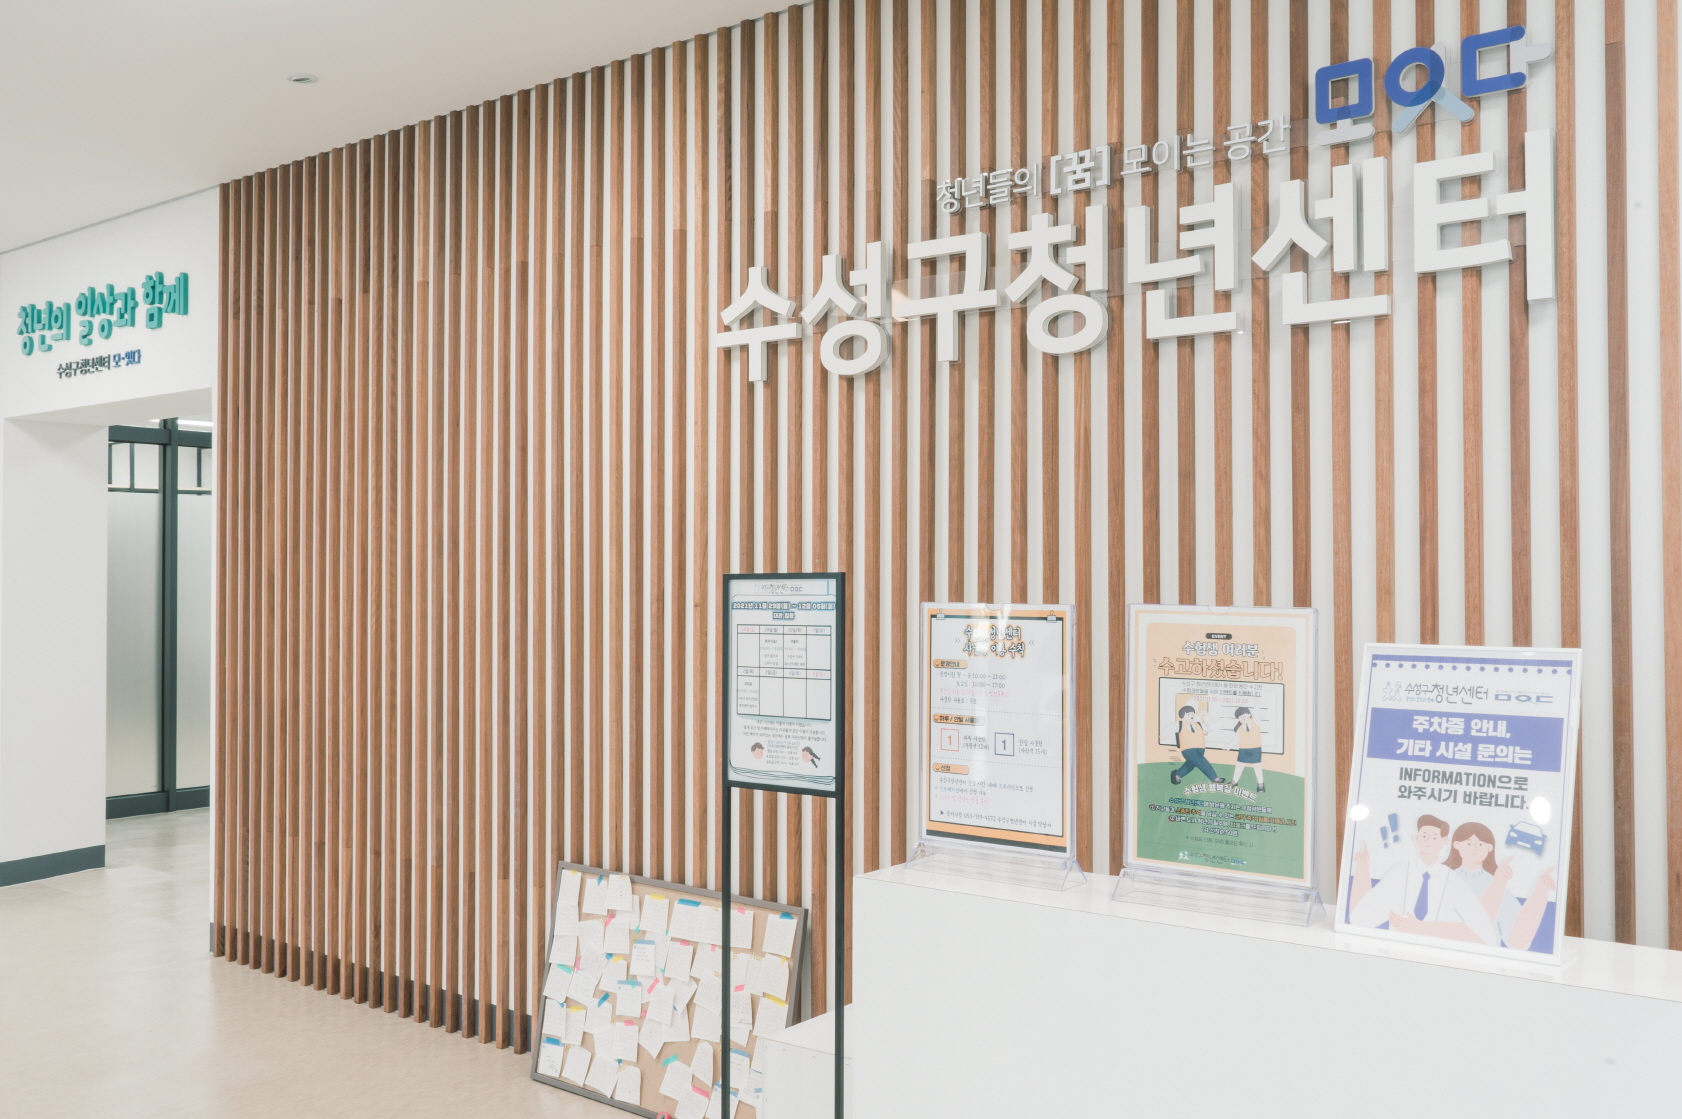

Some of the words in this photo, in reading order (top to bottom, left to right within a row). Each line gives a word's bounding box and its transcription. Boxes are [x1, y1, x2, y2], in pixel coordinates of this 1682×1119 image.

[937, 162, 1043, 214] 청년들의
[1050, 145, 1112, 195] [꿈]
[1120, 132, 1215, 177] 모이는
[1223, 114, 1292, 162] 공간
[716, 129, 1555, 382] 수성구청년센터
[17, 301, 71, 355] 청년의
[75, 284, 138, 346] 일상과
[142, 271, 189, 329] 함께
[57, 354, 110, 379] 수성구청년센터
[1008, 643, 1025, 659] 수칙
[1182, 641, 1218, 657] 수험생
[1222, 642, 1259, 658] 여러분
[1158, 656, 1284, 681] 수고하셨습니다!
[1404, 682, 1488, 705] 수성구청년센터
[1412, 715, 1465, 735] 주차증
[1470, 719, 1511, 738] 안내,
[947, 735, 952, 746] 1
[1002, 739, 1007, 751] 1
[1396, 738, 1432, 757] 기타
[1436, 741, 1472, 760] 시설
[1477, 743, 1532, 765] 문의는
[1399, 766, 1529, 791] INFORMATION으로
[1397, 785, 1458, 804] 와주시기
[1463, 790, 1529, 810] 바랍니다.
